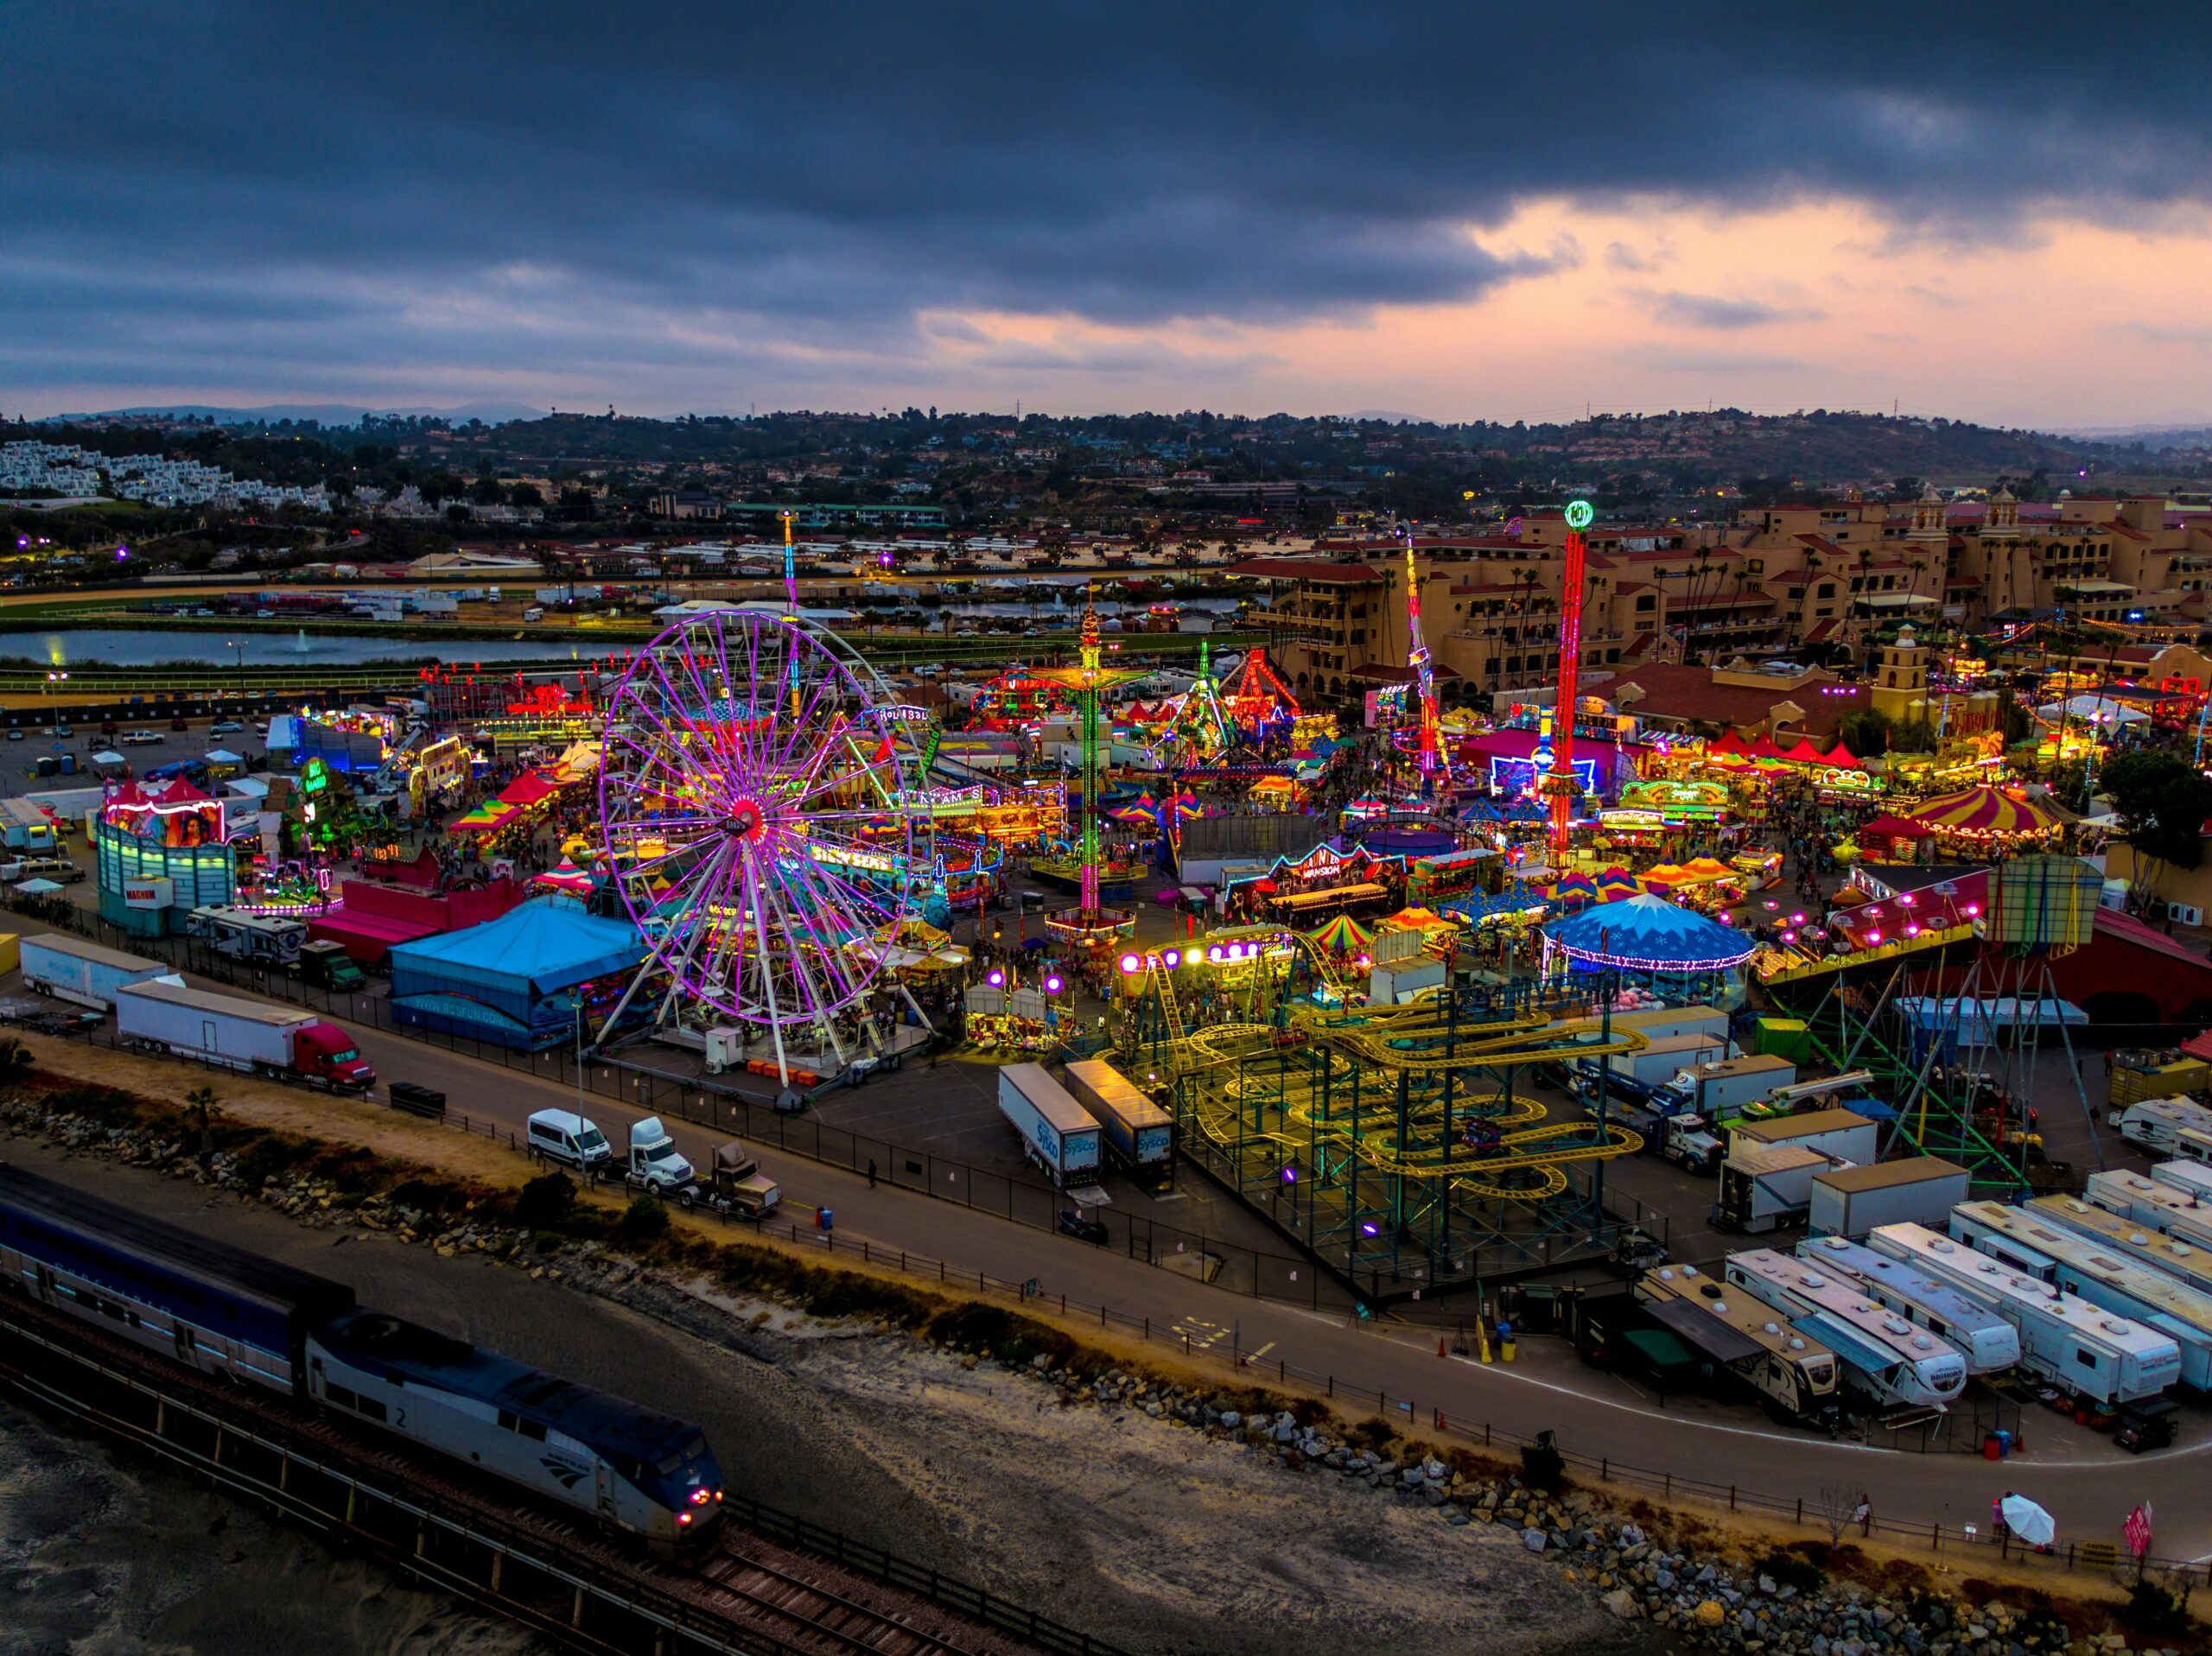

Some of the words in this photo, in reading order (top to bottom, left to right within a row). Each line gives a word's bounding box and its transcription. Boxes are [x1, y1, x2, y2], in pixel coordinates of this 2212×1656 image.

[880, 710, 899, 721] ROL
[308, 760, 321, 778] BIG
[1303, 848, 1340, 869] HAUNTED
[1303, 865, 1340, 879] MANSION
[126, 890, 156, 900] MAGNUM
[1037, 1123, 1058, 1159] Sysco
[1065, 1141, 1096, 1156] Sysco
[1137, 1137, 1168, 1152] Sysco
[1930, 1368, 1963, 1381] BIGHORN
[396, 1407, 406, 1428] 2
